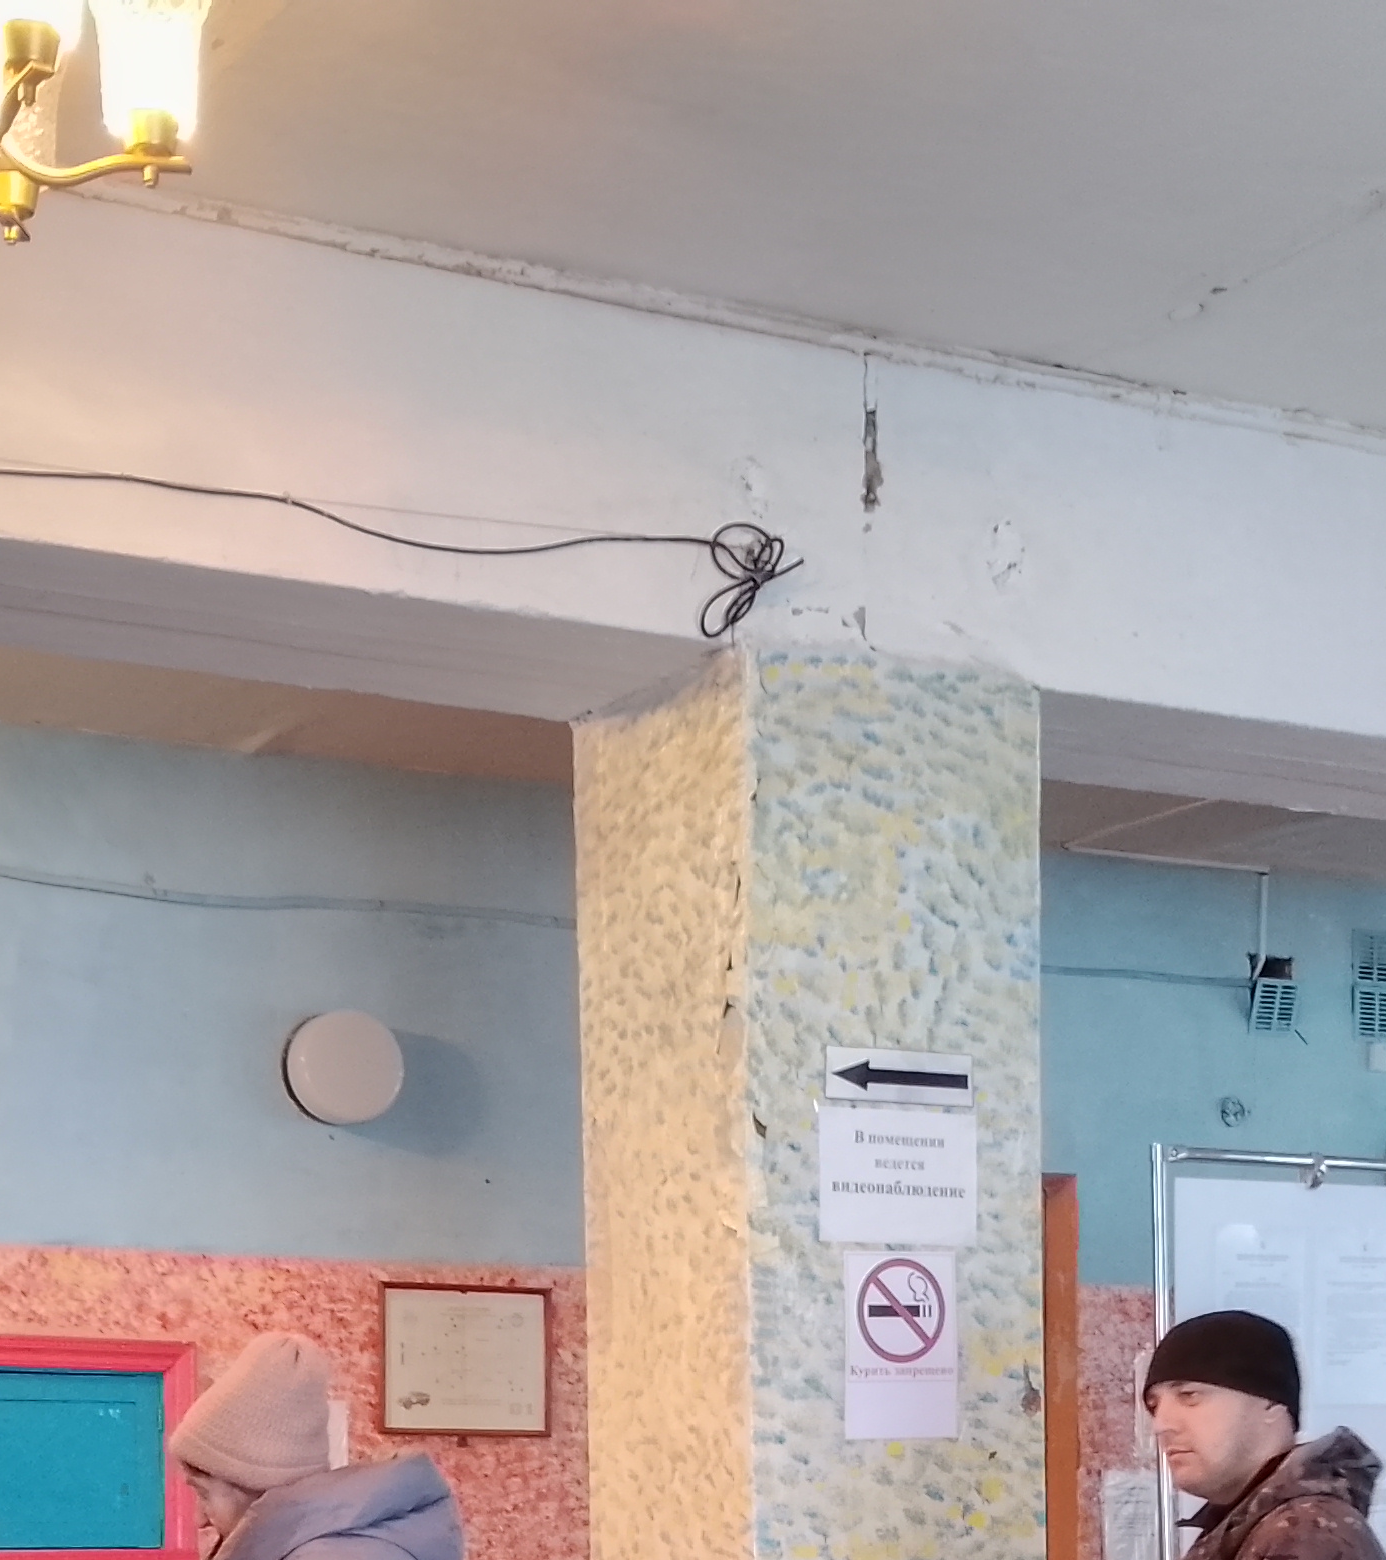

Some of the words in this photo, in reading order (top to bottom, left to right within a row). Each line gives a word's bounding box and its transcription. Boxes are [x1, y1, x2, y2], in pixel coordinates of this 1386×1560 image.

[853, 1129, 866, 1146] В
[868, 1132, 945, 1149] помещении
[874, 1157, 925, 1172] ведется
[831, 1179, 966, 1200] видеонаблюдение
[849, 1364, 889, 1380] Курить
